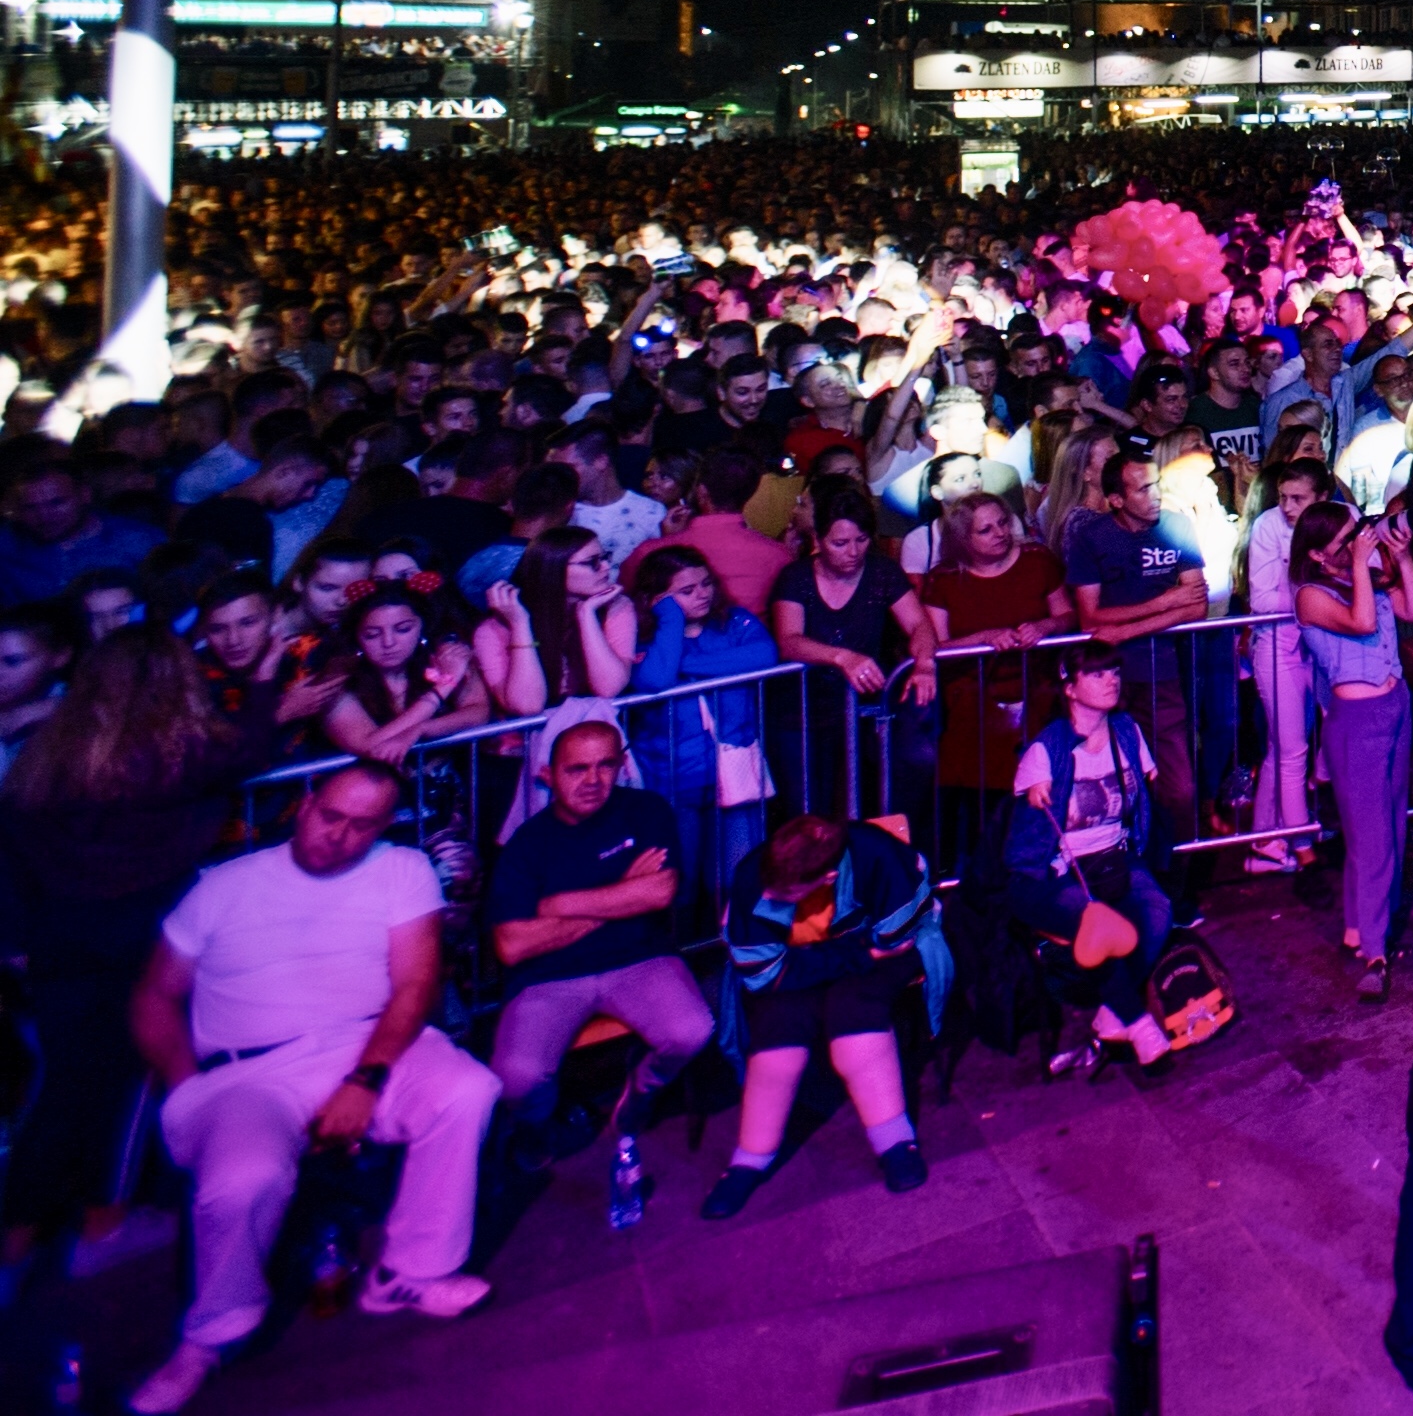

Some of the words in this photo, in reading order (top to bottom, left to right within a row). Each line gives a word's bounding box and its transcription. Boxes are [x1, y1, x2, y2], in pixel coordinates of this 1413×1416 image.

[979, 62, 1029, 76] ZLATEN
[1034, 61, 1061, 75] DAB
[1315, 58, 1358, 71] ZLATEN
[1361, 58, 1383, 70] DAB
